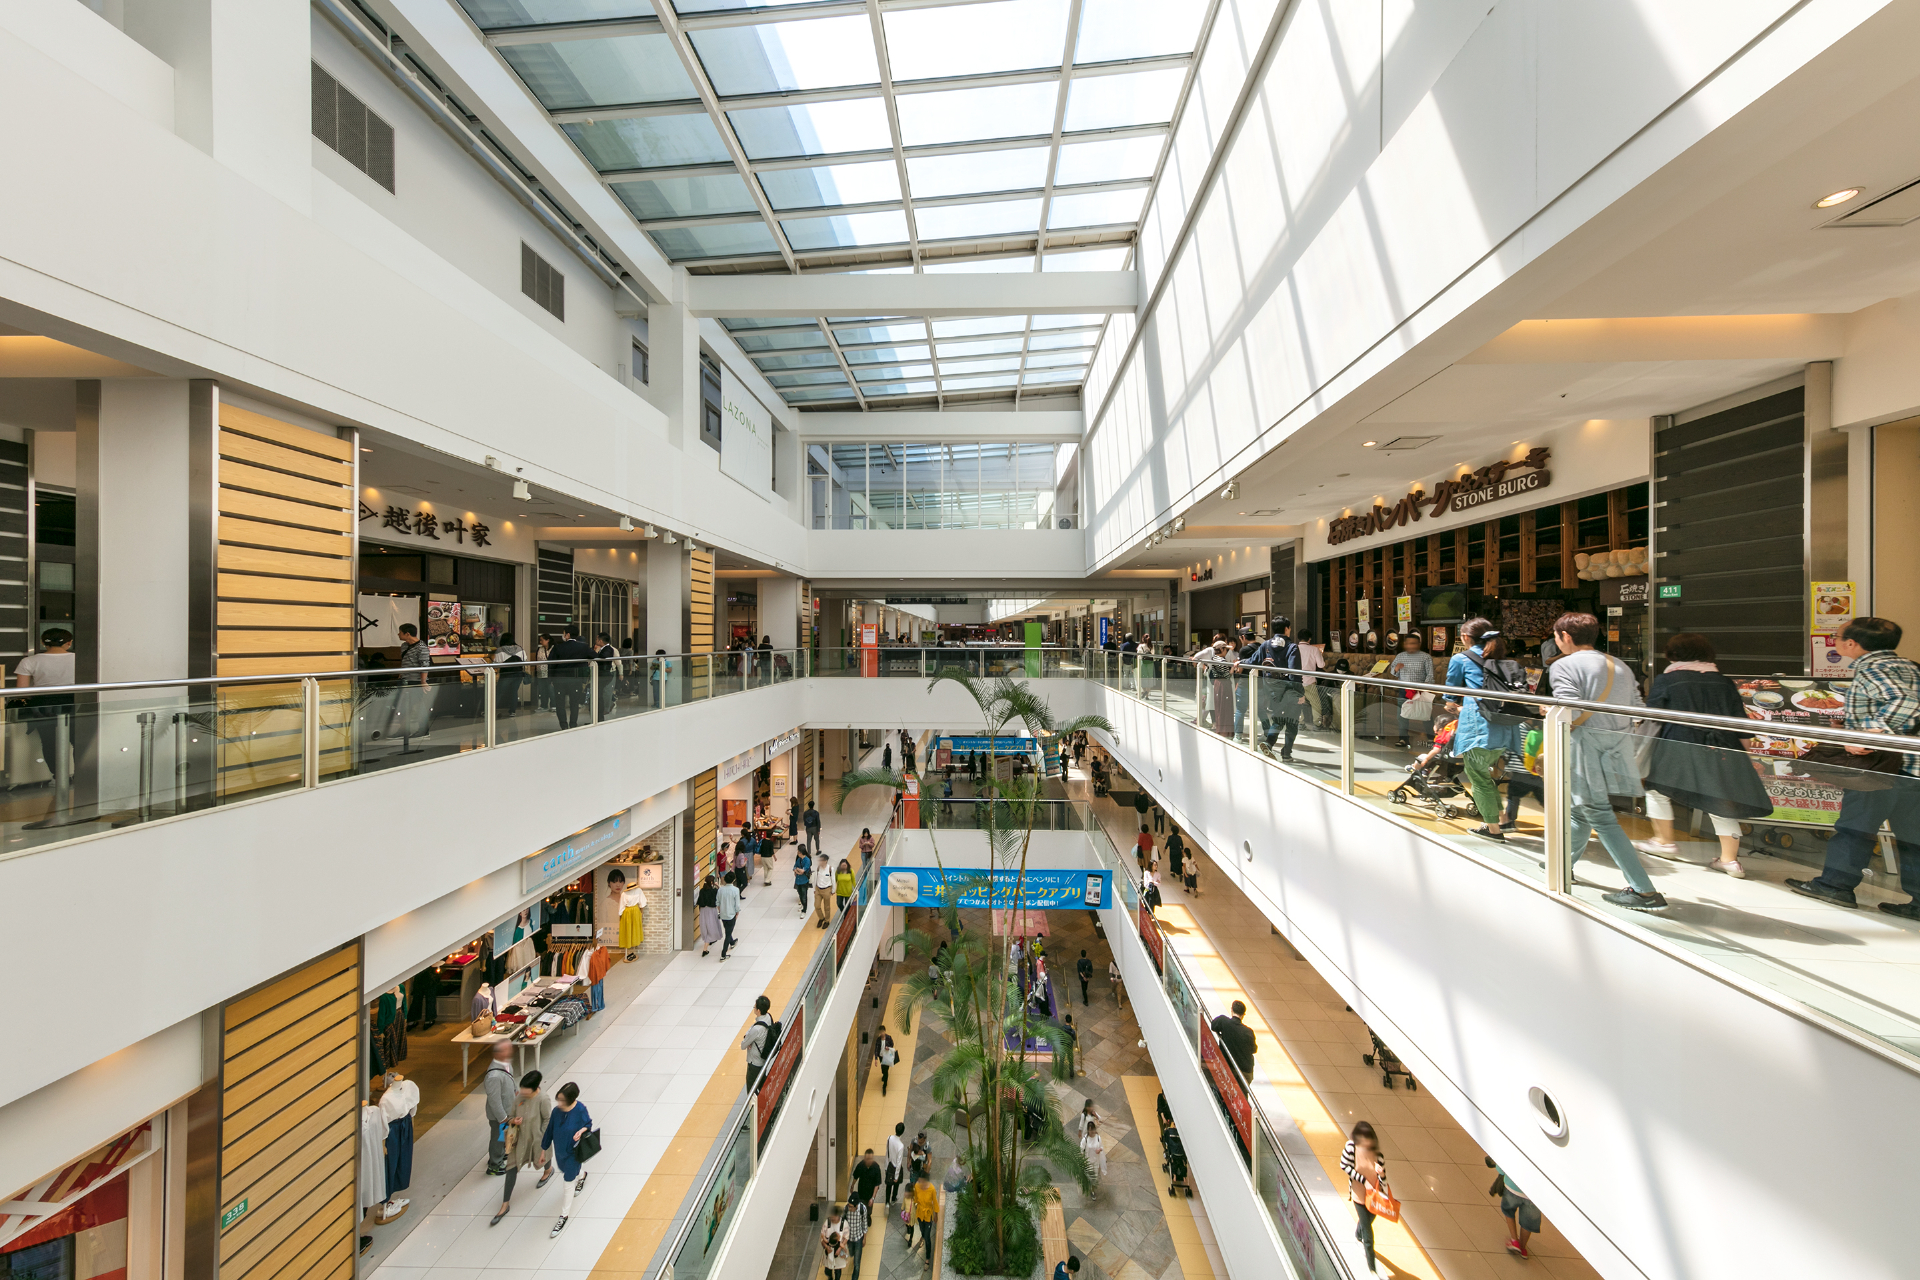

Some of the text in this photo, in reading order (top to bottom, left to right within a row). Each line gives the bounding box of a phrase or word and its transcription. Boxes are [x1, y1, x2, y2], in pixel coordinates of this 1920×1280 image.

[723, 395, 757, 437] LAZONA
[1455, 473, 1539, 509] STONE BURG
[383, 505, 492, 548] 越後叶家
[1663, 586, 1677, 594] 411
[543, 844, 574, 872] earth
[226, 1202, 245, 1221] 338
